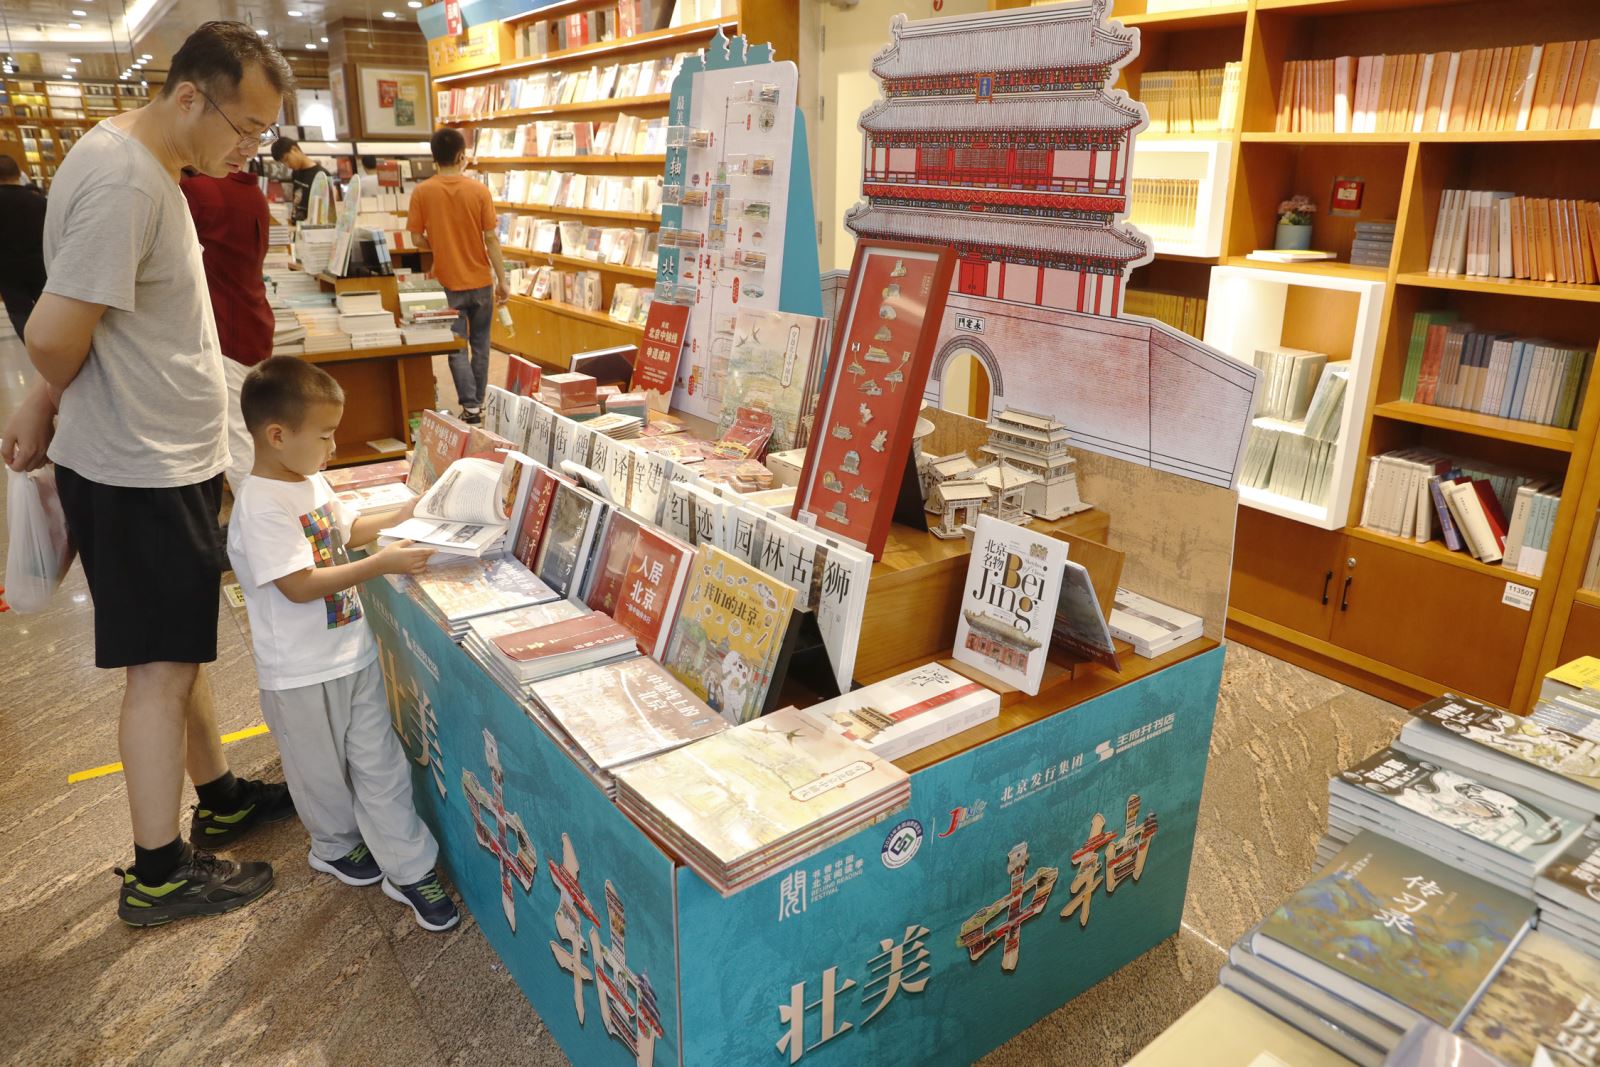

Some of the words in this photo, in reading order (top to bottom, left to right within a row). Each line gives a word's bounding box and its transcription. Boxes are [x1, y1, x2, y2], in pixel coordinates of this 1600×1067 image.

[668, 491, 714, 542] 红迹
[734, 517, 785, 572] 园林
[983, 553, 1005, 571] 名物
[984, 539, 1008, 557] 北京
[635, 555, 664, 587] 人居
[789, 545, 852, 605] 古狮
[1001, 552, 1048, 603] Bei
[630, 579, 657, 611] 北京
[703, 582, 760, 626] 我们的北京
[972, 566, 1038, 634] Jing
[638, 690, 668, 711] 北京
[1116, 712, 1176, 748] 王府井书店
[1000, 752, 1085, 802] 北京发行集团
[811, 887, 840, 904] FESTIVAL
[1373, 874, 1444, 936] 传习录
[776, 793, 1159, 1065] 壮美中轴
